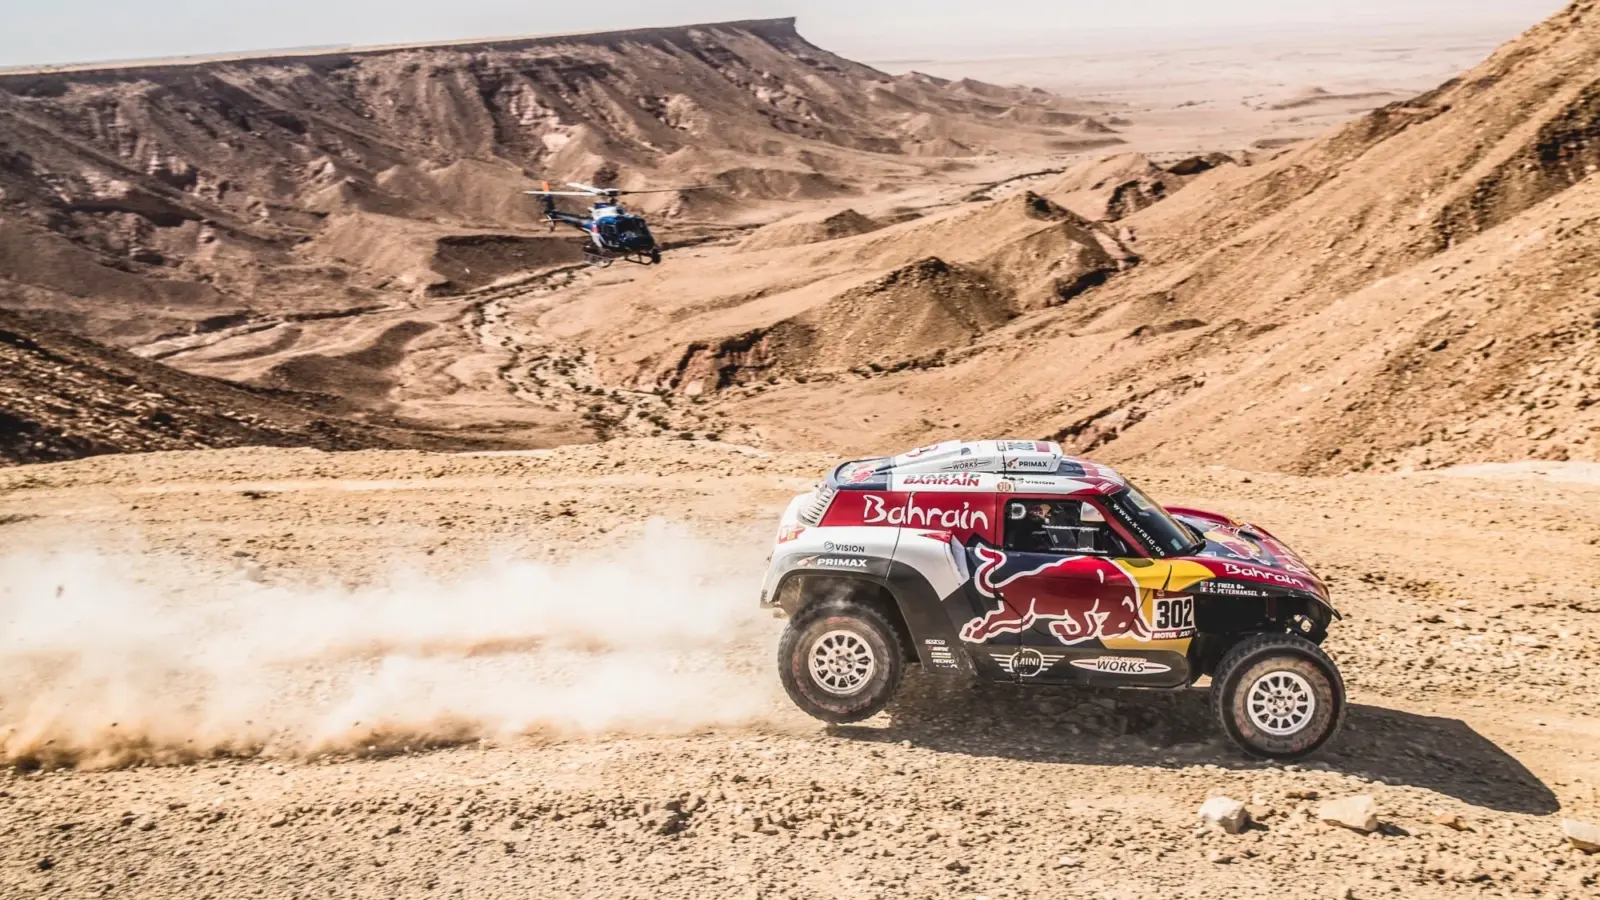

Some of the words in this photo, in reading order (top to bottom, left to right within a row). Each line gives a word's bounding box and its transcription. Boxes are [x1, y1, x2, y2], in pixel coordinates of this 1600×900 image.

[952, 461, 978, 470] WORKS
[1018, 460, 1047, 468] PRIMAX
[903, 478, 980, 487] BAHRAIN
[863, 492, 988, 530] Bahrain
[1113, 503, 1165, 556] www.x-raid.de
[836, 544, 865, 553] VISION
[817, 558, 867, 568] PRIMAX
[1223, 562, 1304, 588] Bahrain
[1217, 588, 1258, 597] PETERHANSEL
[1156, 598, 1192, 629] 302
[1153, 631, 1178, 639] MOTUL
[1013, 657, 1039, 668] MINI
[1097, 660, 1145, 673] WORKS
